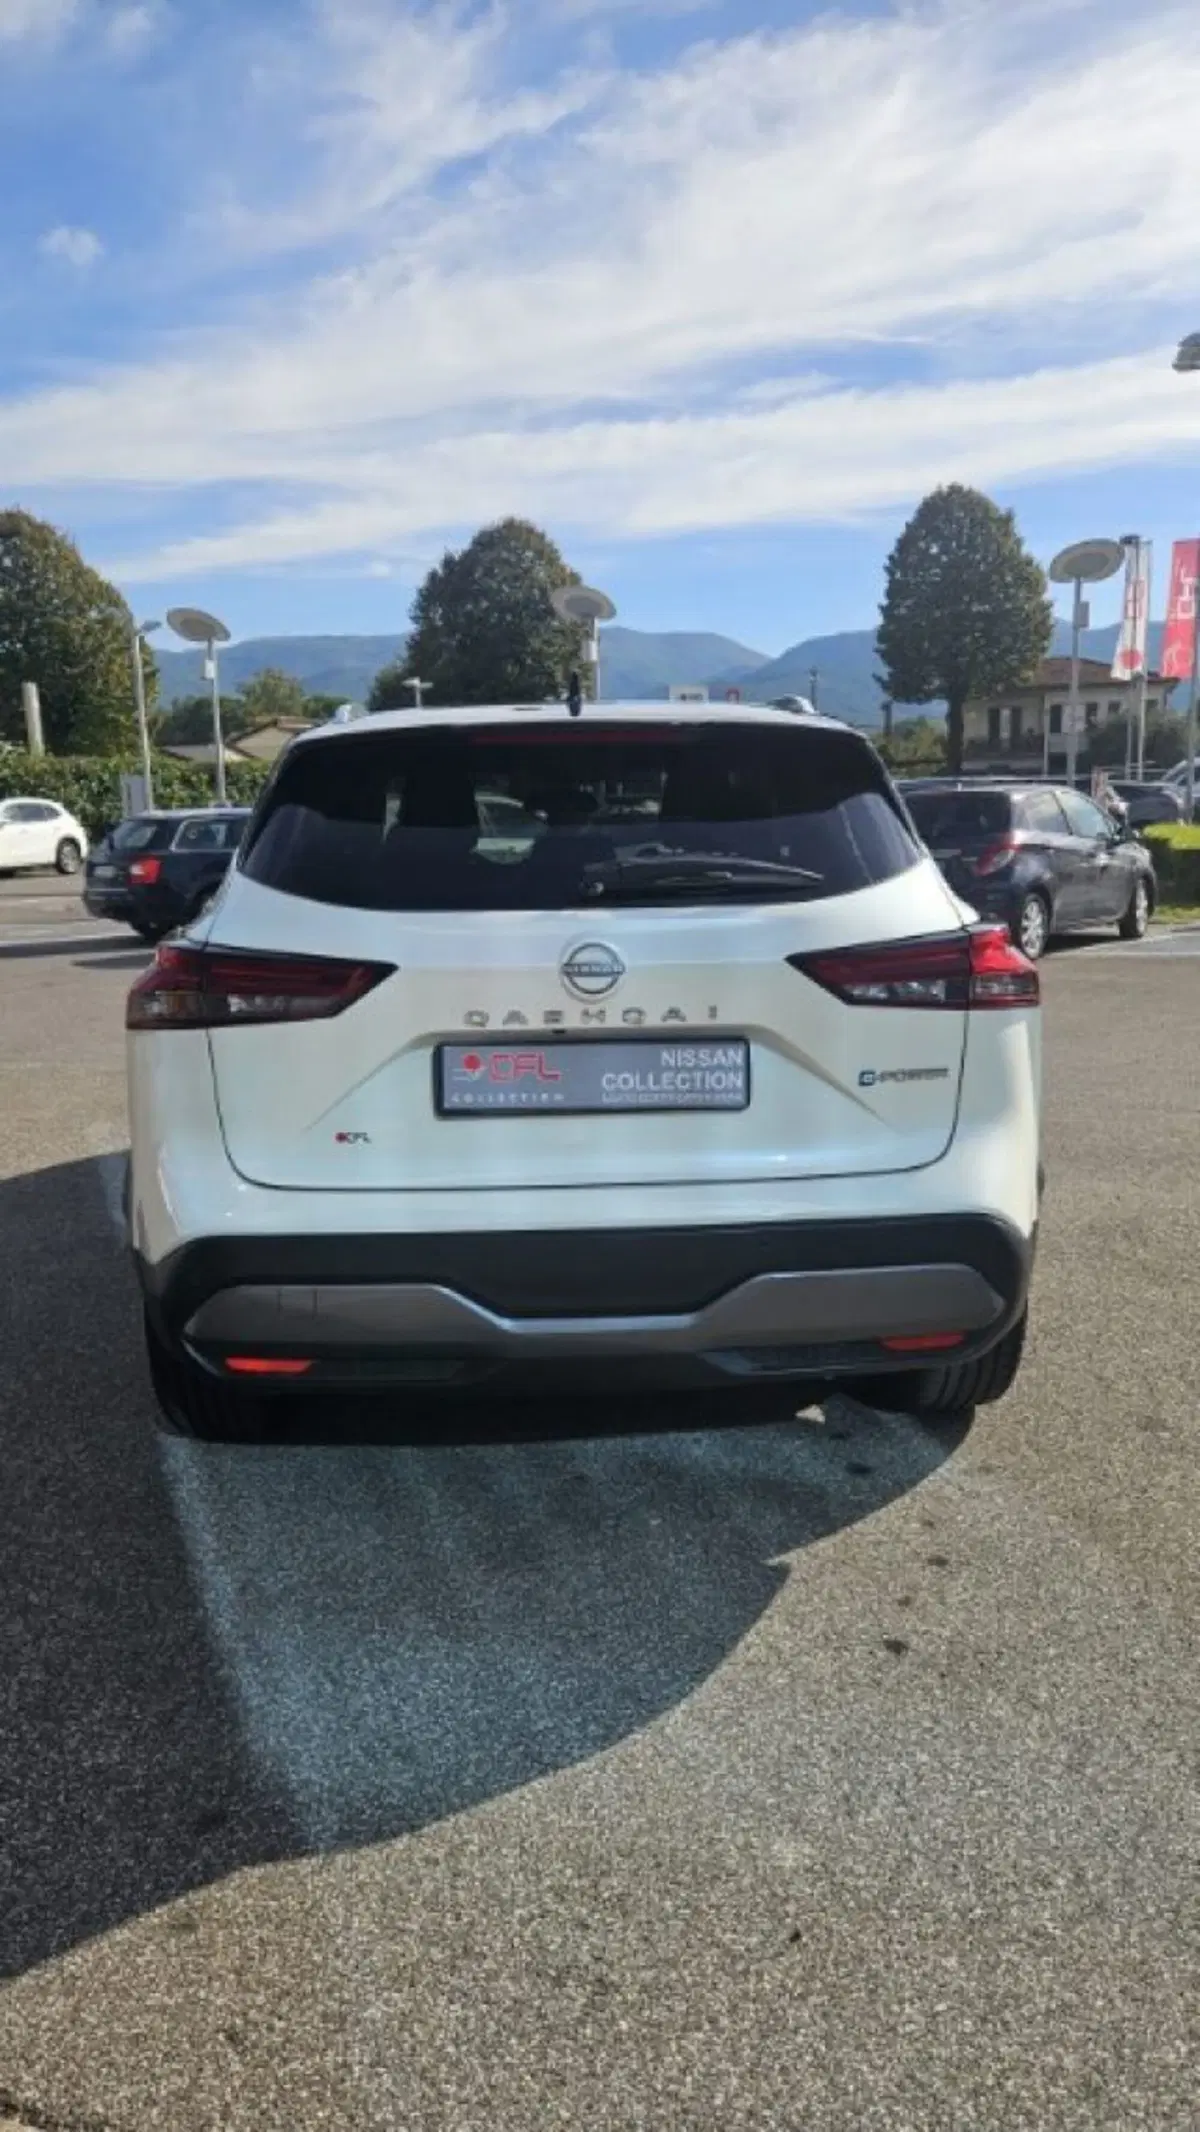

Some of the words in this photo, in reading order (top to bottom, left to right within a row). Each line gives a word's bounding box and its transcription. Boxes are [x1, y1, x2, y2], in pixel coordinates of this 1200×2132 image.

[463, 1006, 718, 1028] QASHQAI
[488, 1051, 562, 1082] CFL
[661, 1049, 743, 1067] NISSAN
[601, 1071, 743, 1091] COLLECTION
